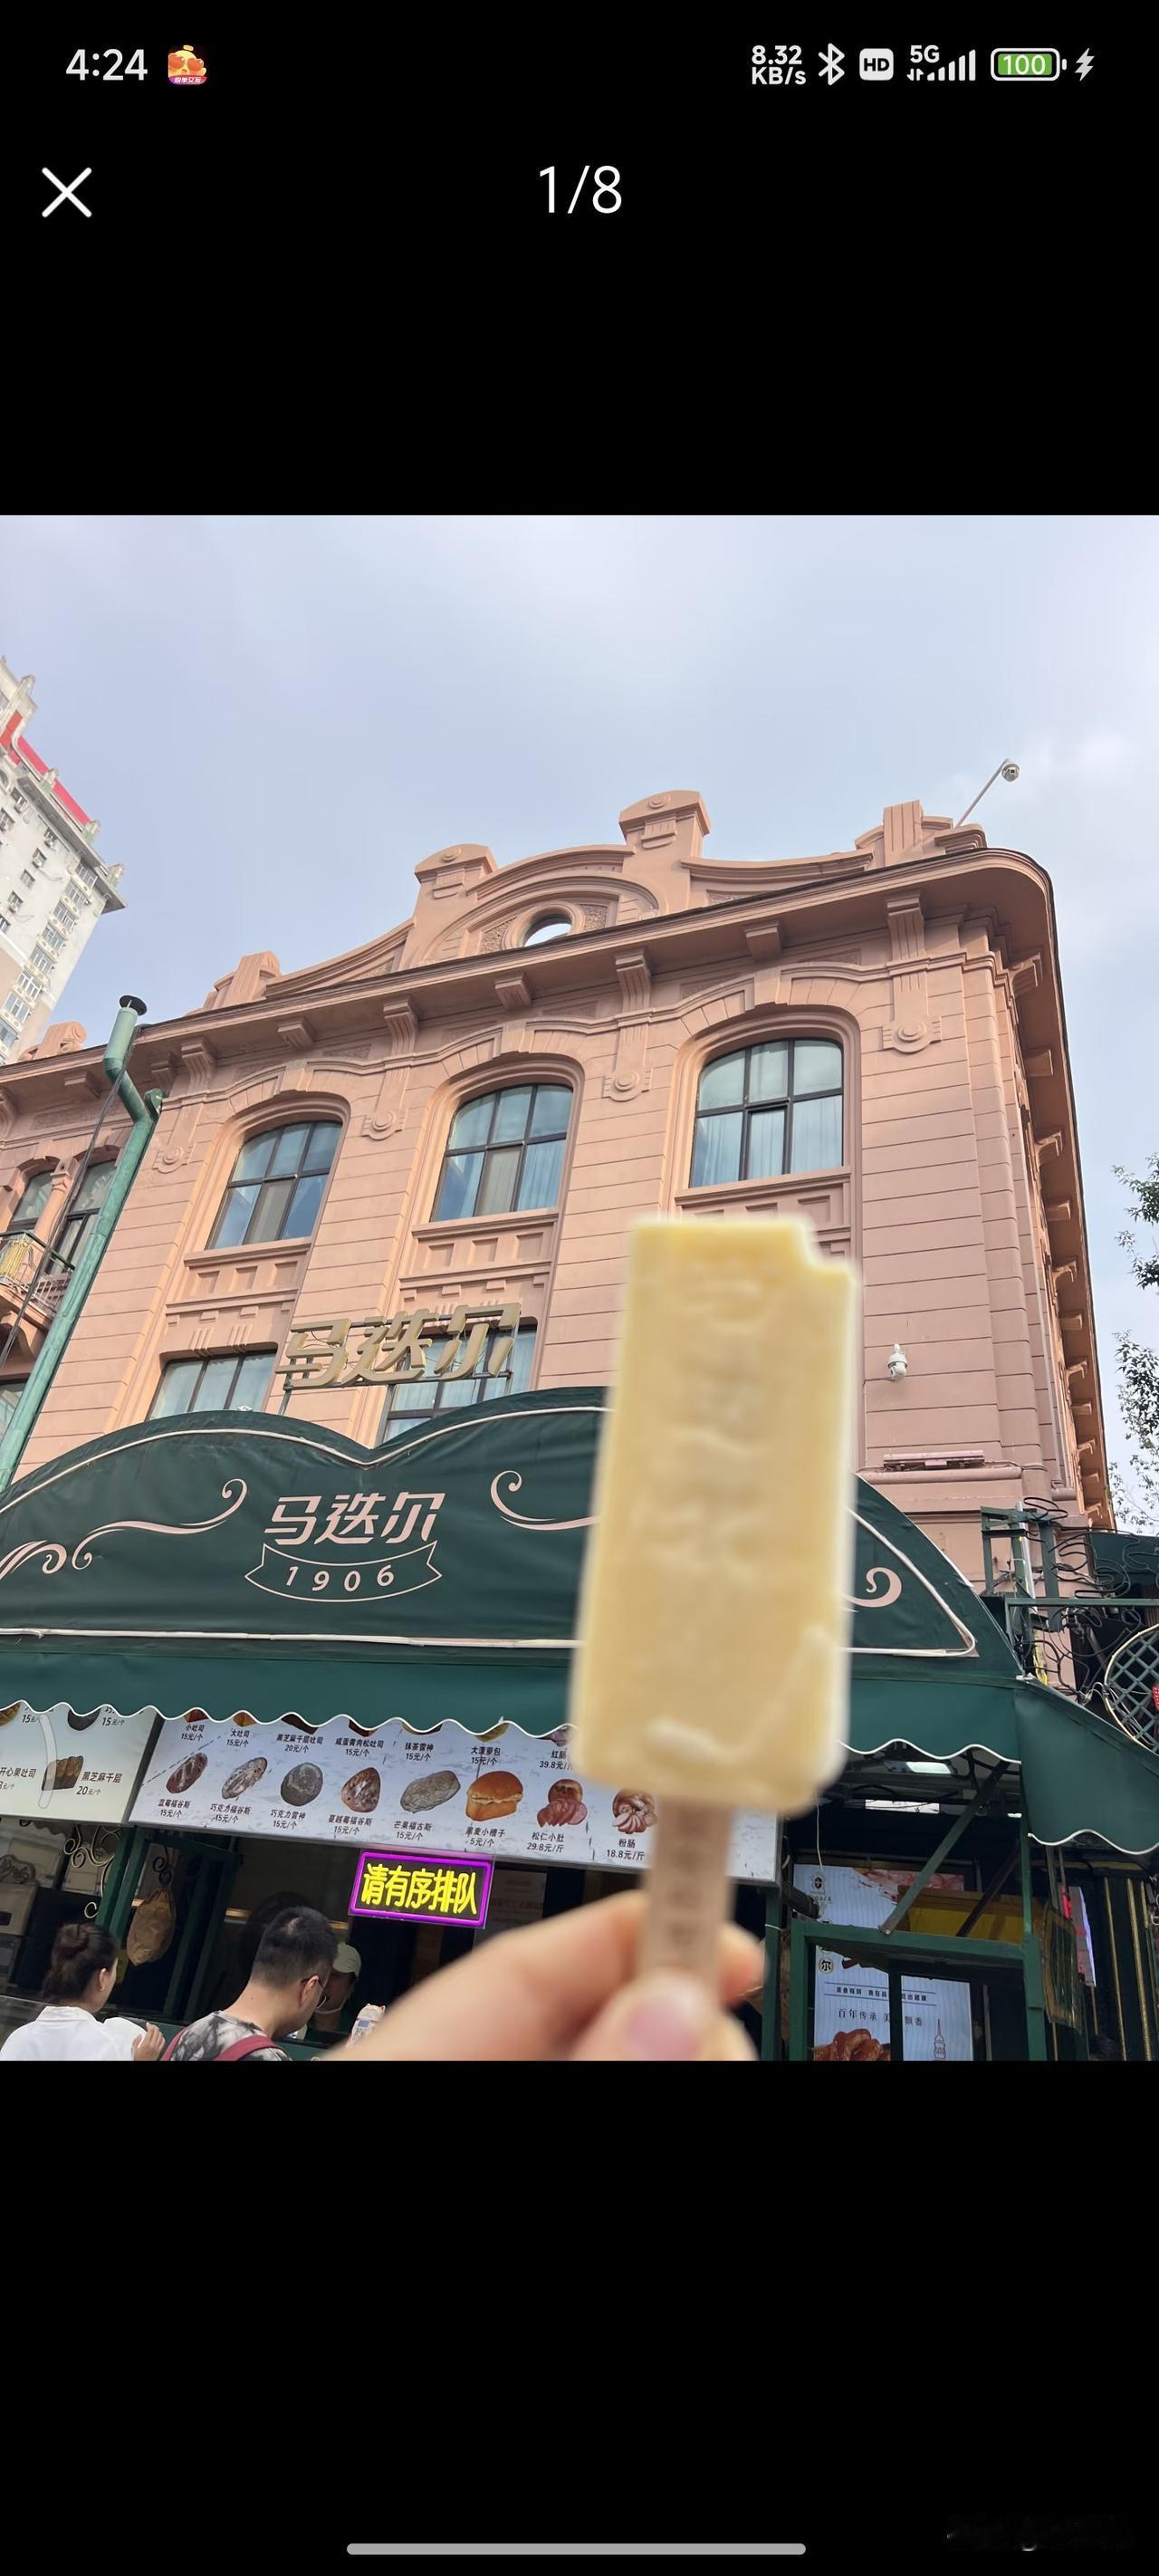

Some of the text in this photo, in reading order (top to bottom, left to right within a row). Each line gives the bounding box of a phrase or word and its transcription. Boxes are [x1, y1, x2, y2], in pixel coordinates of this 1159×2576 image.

[275, 1302, 522, 1388] 马迭尔
[264, 1492, 445, 1545] 马迭尔
[286, 1565, 394, 1591] 1906
[185, 1724, 205, 1732] 小吐司
[181, 1733, 204, 1741] 15元/个
[230, 1729, 250, 1738] 大吐司
[226, 1738, 249, 1747] 15元/个
[284, 1744, 310, 1754] 20元/个
[345, 1748, 369, 1758] 15元/个
[406, 1753, 431, 1762] 15元/个
[471, 1756, 497, 1766] 15元/个
[81, 1772, 123, 1783] 黑芝麻千层
[76, 1786, 101, 1796] 20元/个
[160, 1809, 182, 1819] 15元/个
[216, 1814, 239, 1824] 15元/个
[273, 1820, 297, 1830] 15元/个
[334, 1825, 359, 1836] 15元/个
[397, 1831, 423, 1841] 15元/个
[532, 1831, 564, 1842] 松仁小肚
[527, 1842, 564, 1853] 29.8元/斤
[618, 1838, 636, 1849] 粉肠
[607, 1849, 645, 1860] 18.8元/斤
[360, 1862, 478, 1915] 请有序排队
